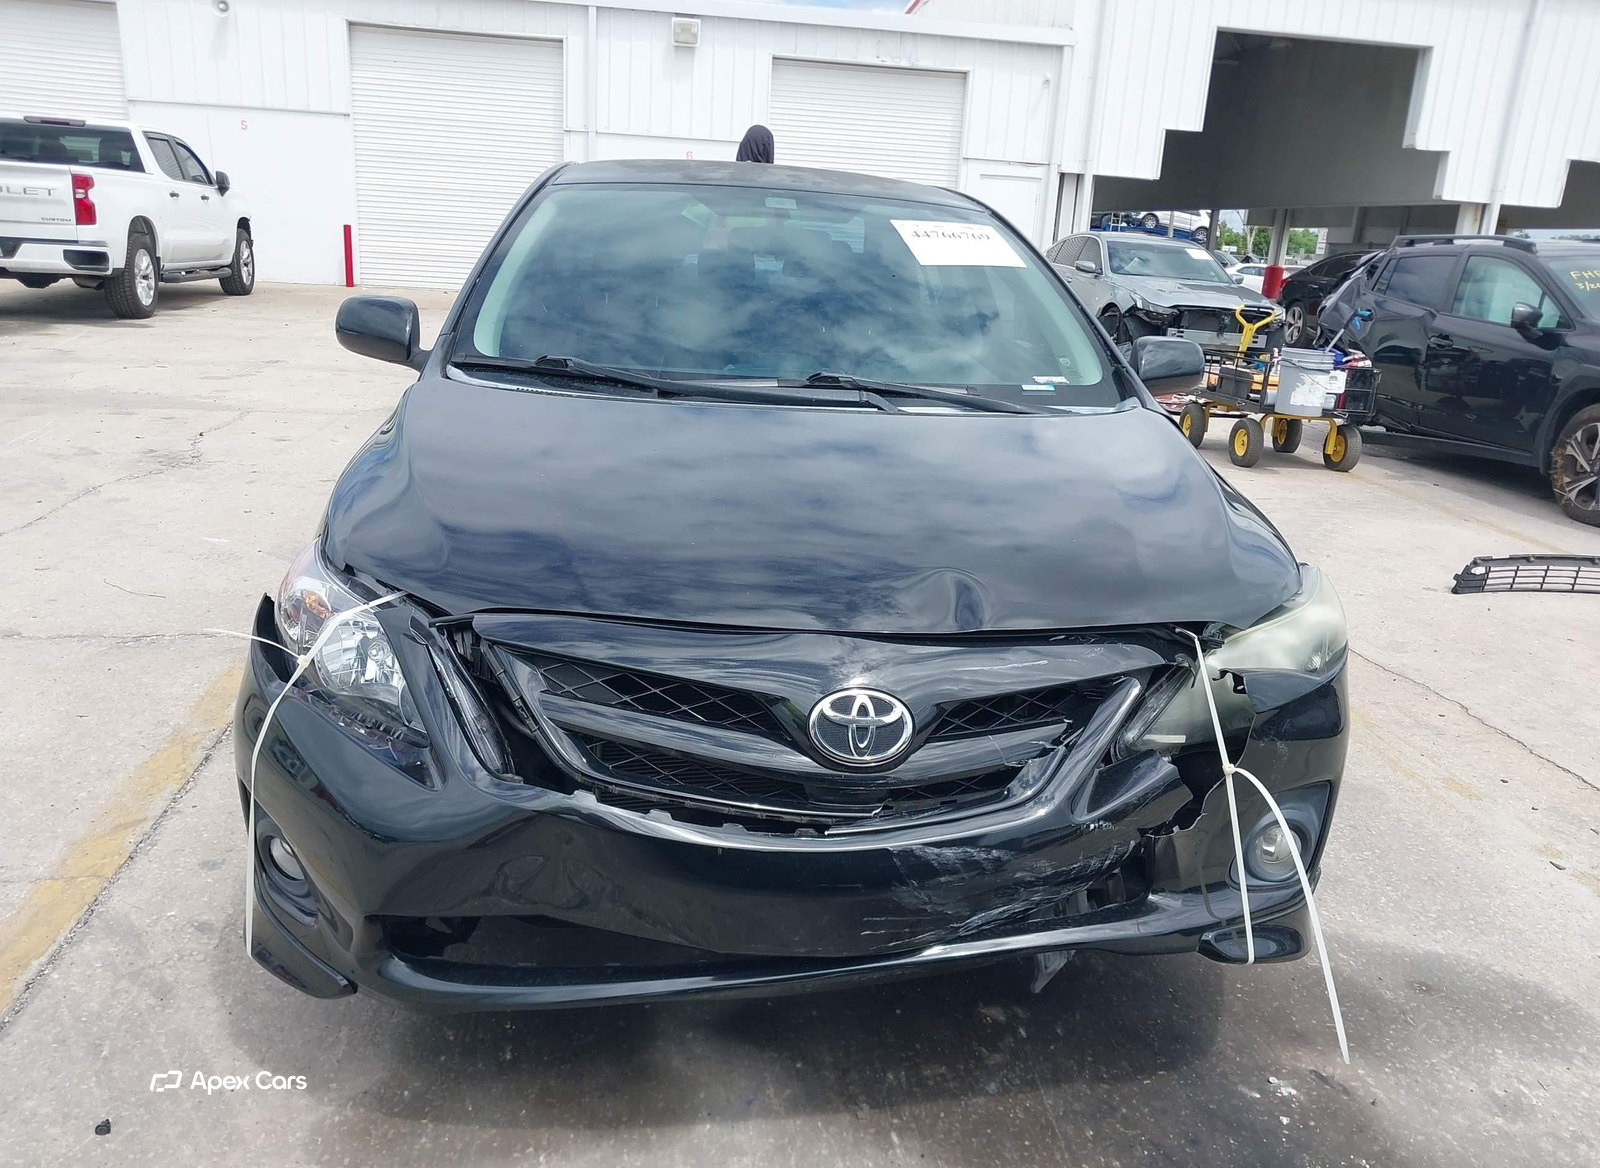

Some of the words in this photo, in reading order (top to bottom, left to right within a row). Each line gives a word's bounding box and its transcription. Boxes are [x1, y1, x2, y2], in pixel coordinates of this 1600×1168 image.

[240, 119, 249, 131] 5
[685, 150, 694, 160] 6
[0, 185, 57, 196] LET
[911, 230, 991, 241] 44766769
